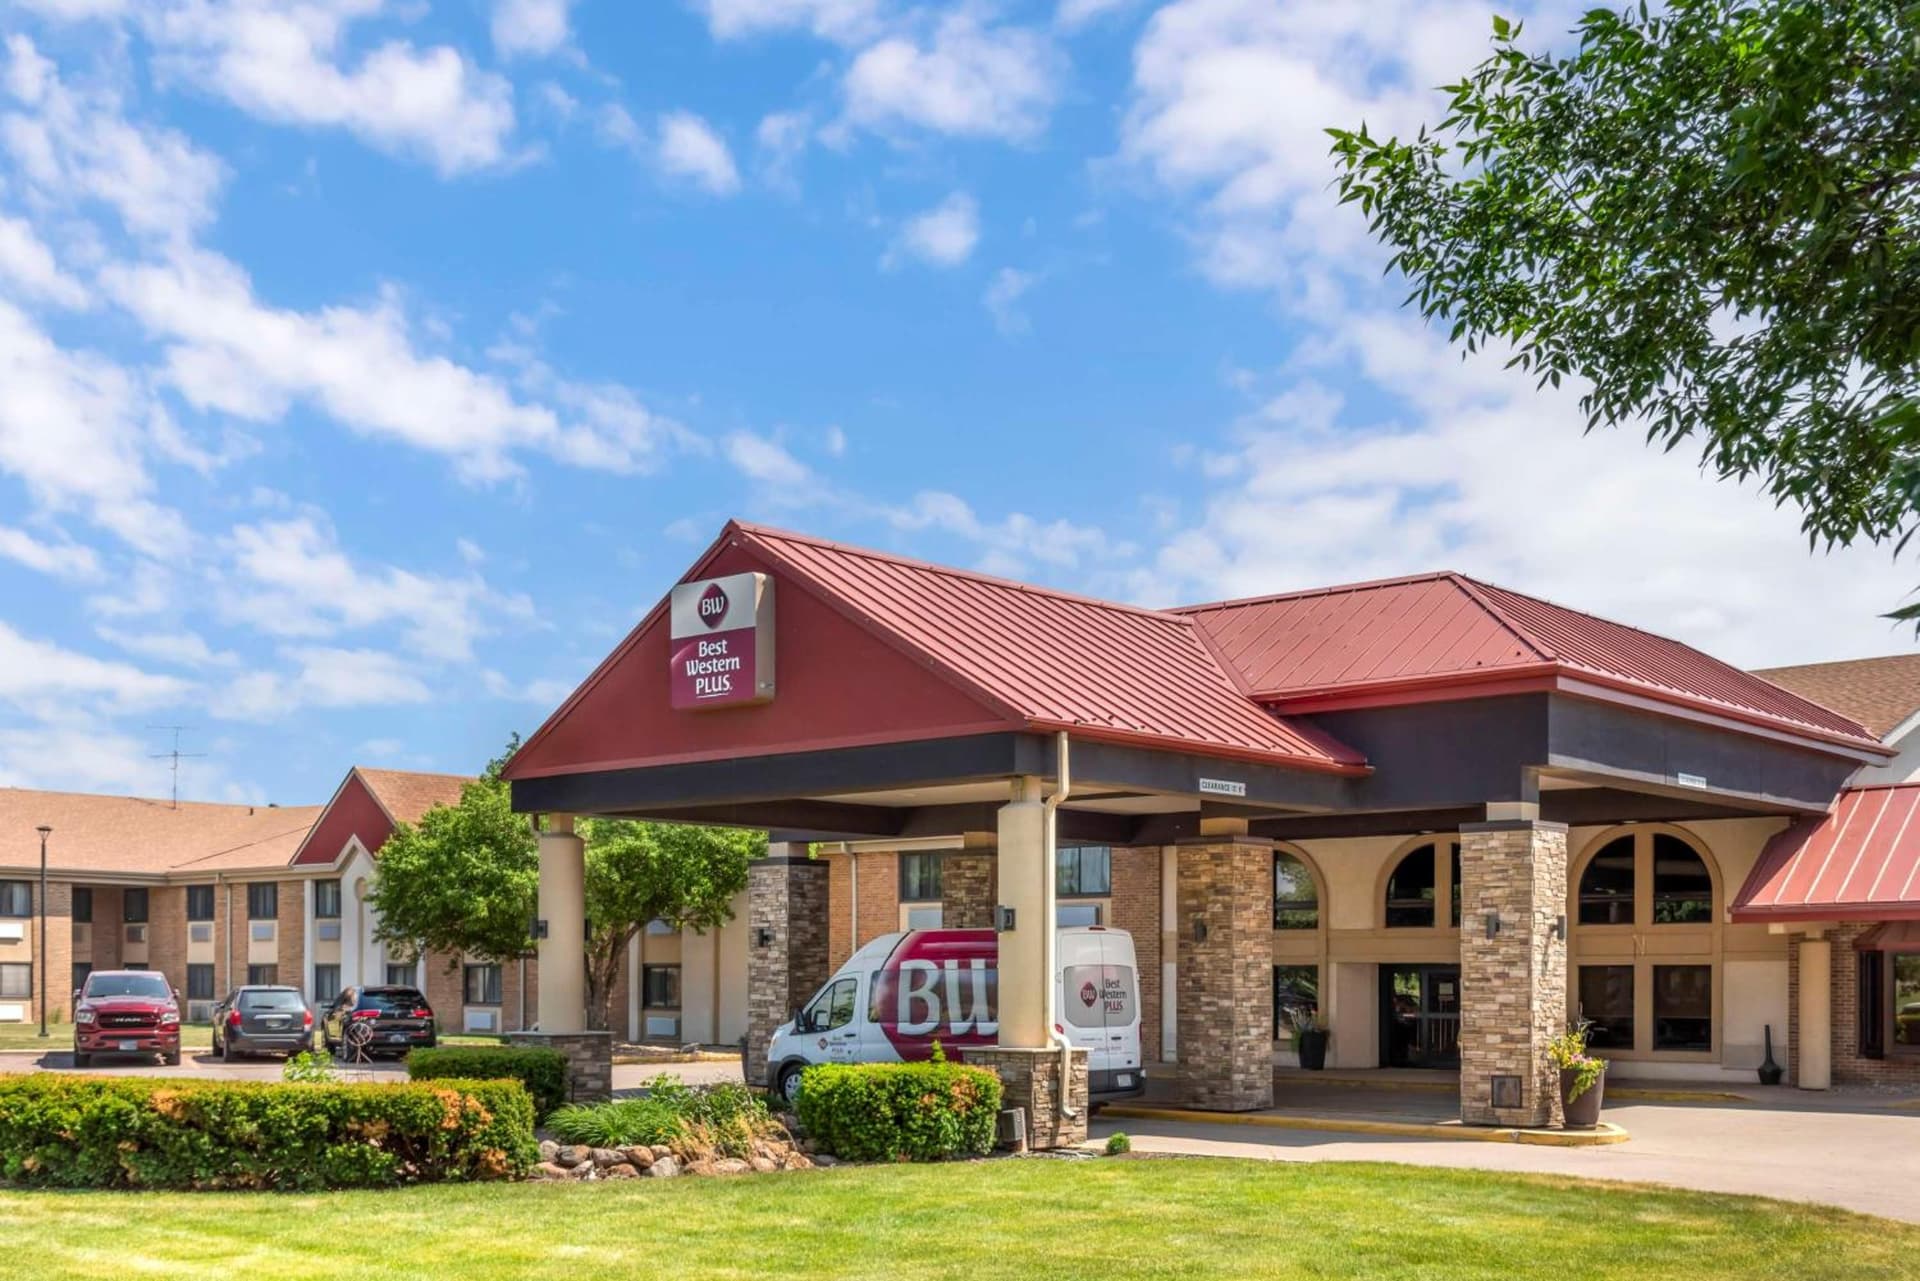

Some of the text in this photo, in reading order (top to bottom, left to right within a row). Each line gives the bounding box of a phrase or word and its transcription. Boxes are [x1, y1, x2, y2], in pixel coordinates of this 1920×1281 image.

[702, 596, 724, 616] BW
[698, 640, 727, 657] Best
[686, 656, 740, 676] Western
[695, 674, 731, 695] PLUS
[1105, 979, 1120, 989] Best
[1099, 990, 1127, 1000] Western
[1104, 1000, 1124, 1012] PLUS
